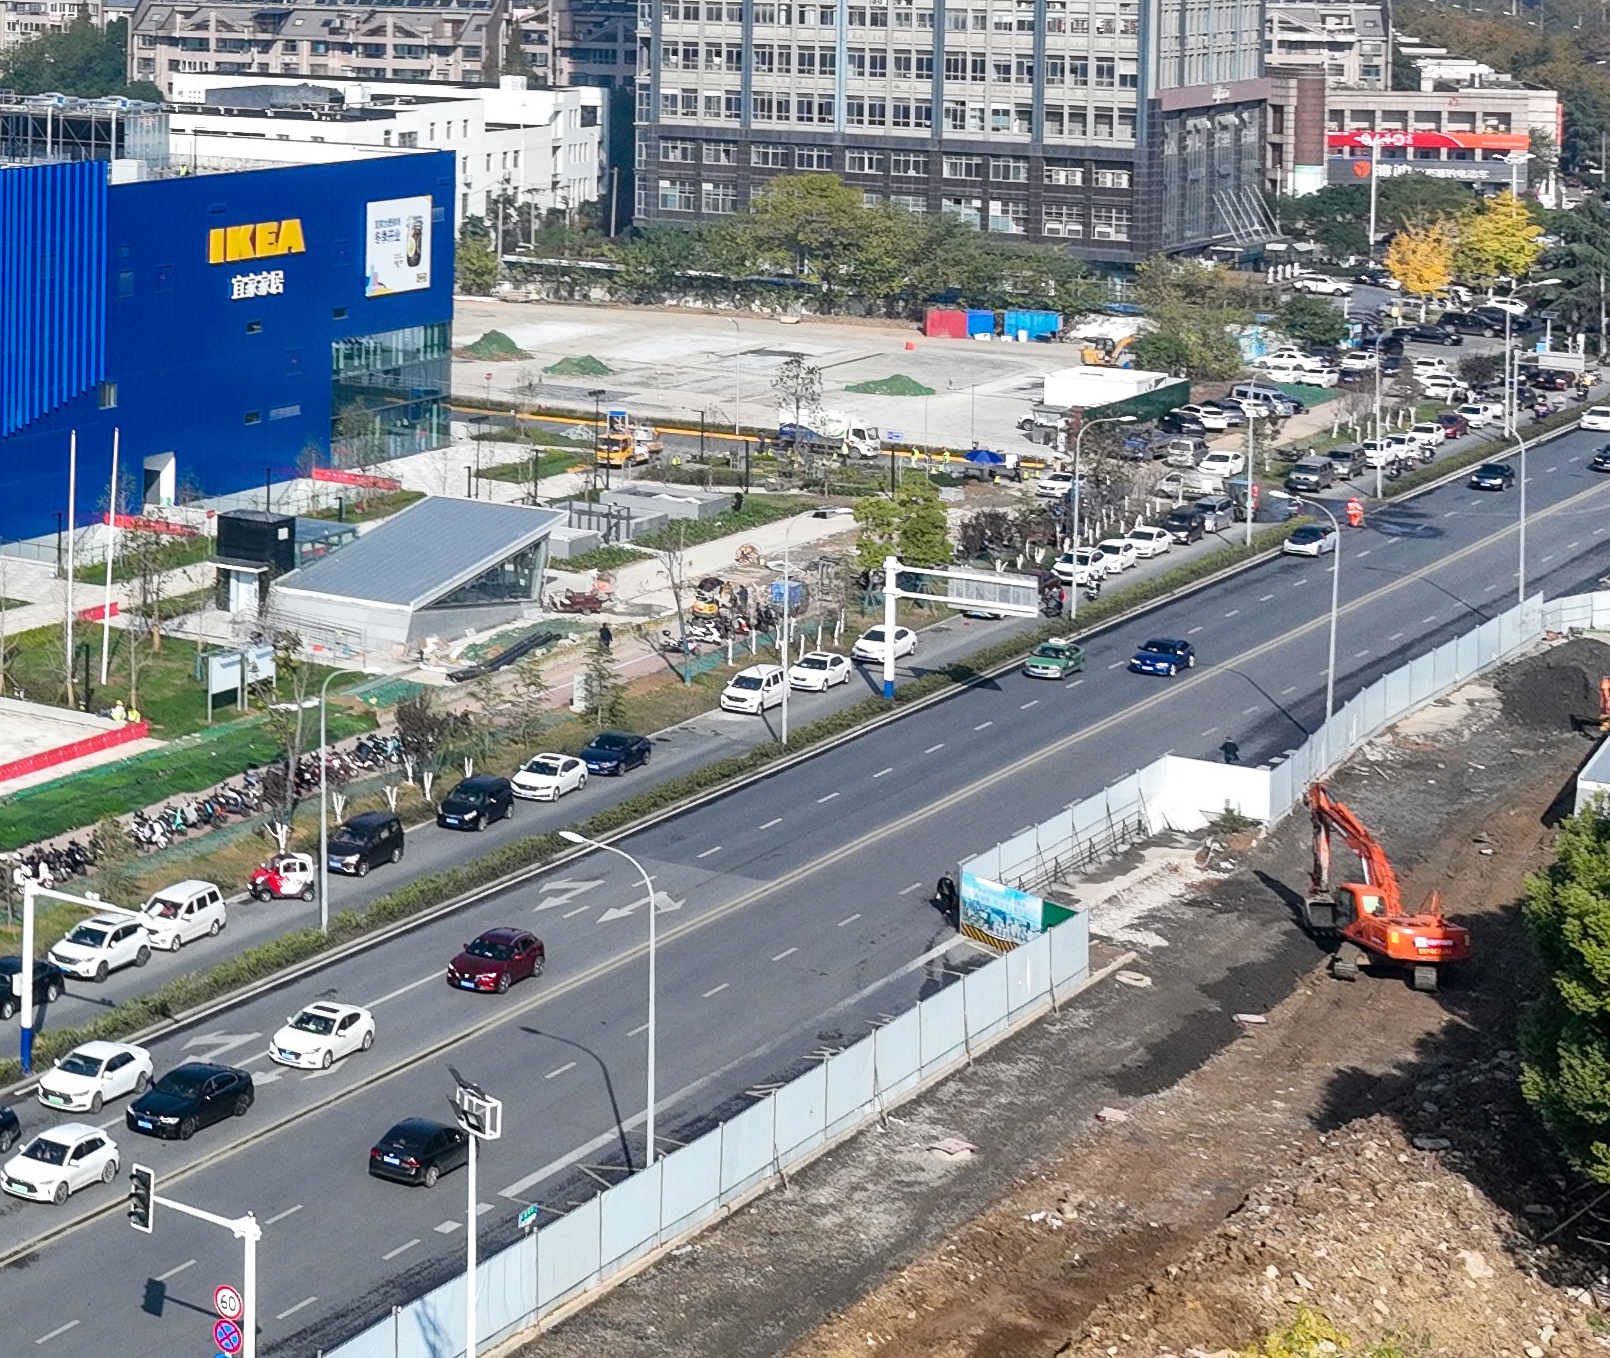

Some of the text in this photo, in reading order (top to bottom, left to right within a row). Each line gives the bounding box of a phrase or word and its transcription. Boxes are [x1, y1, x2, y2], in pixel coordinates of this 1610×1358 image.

[208, 218, 307, 264] IKEA
[230, 269, 285, 300] 宜家家居
[220, 1294, 237, 1312] 60
